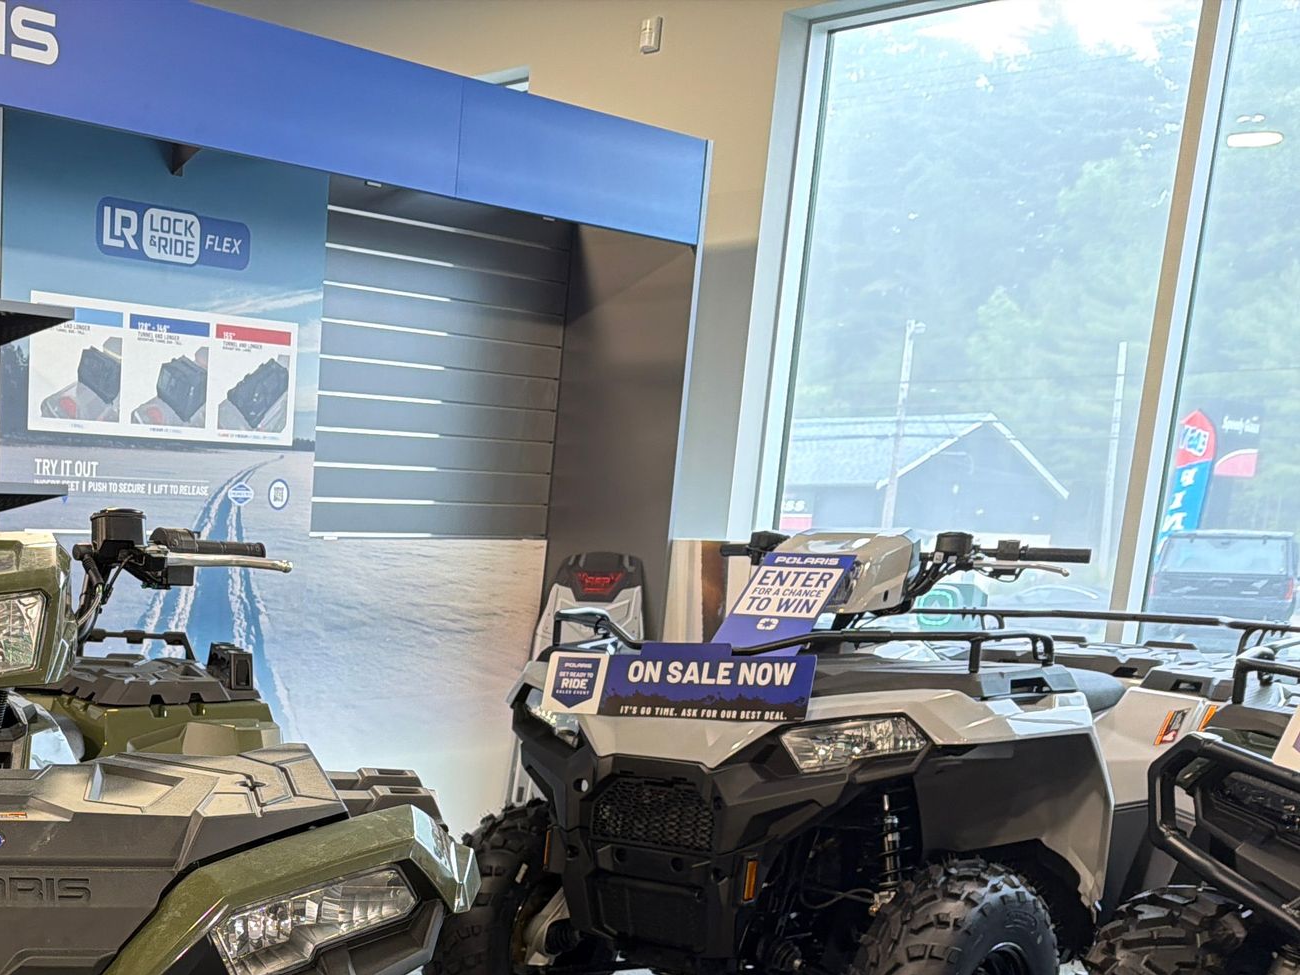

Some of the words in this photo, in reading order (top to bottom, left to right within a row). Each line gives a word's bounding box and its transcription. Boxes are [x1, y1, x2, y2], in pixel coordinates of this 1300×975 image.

[150, 213, 196, 239] LOCK
[205, 234, 243, 255] FLEX
[35, 458, 58, 476] TRY
[60, 460, 73, 476] IT
[74, 461, 100, 478] OUT
[87, 481, 108, 493] PUSH
[109, 483, 118, 493] TO
[118, 483, 146, 495] SECURE
[153, 485, 169, 496] LIFT
[169, 485, 179, 496] TO
[179, 486, 210, 497] RELEASE
[774, 556, 840, 566] POLARIS
[757, 569, 834, 589] ENTER
[751, 586, 770, 596] FOR
[773, 588, 780, 596] A
[782, 588, 825, 599] CHANCE
[746, 596, 773, 612] TO
[775, 598, 819, 614] WIN
[627, 660, 662, 684] ON
[666, 660, 733, 686] SALE
[737, 662, 797, 686] NOW
[561, 678, 589, 690] RIDE
[619, 704, 638, 715] IT'S
[640, 706, 652, 716] GO
[655, 706, 678, 717] TIME.
[681, 707, 698, 718] ASK
[701, 708, 718, 719] FOR
[720, 708, 737, 719] OUR
[740, 709, 761, 720] BEST
[764, 710, 788, 721] DEAL.
